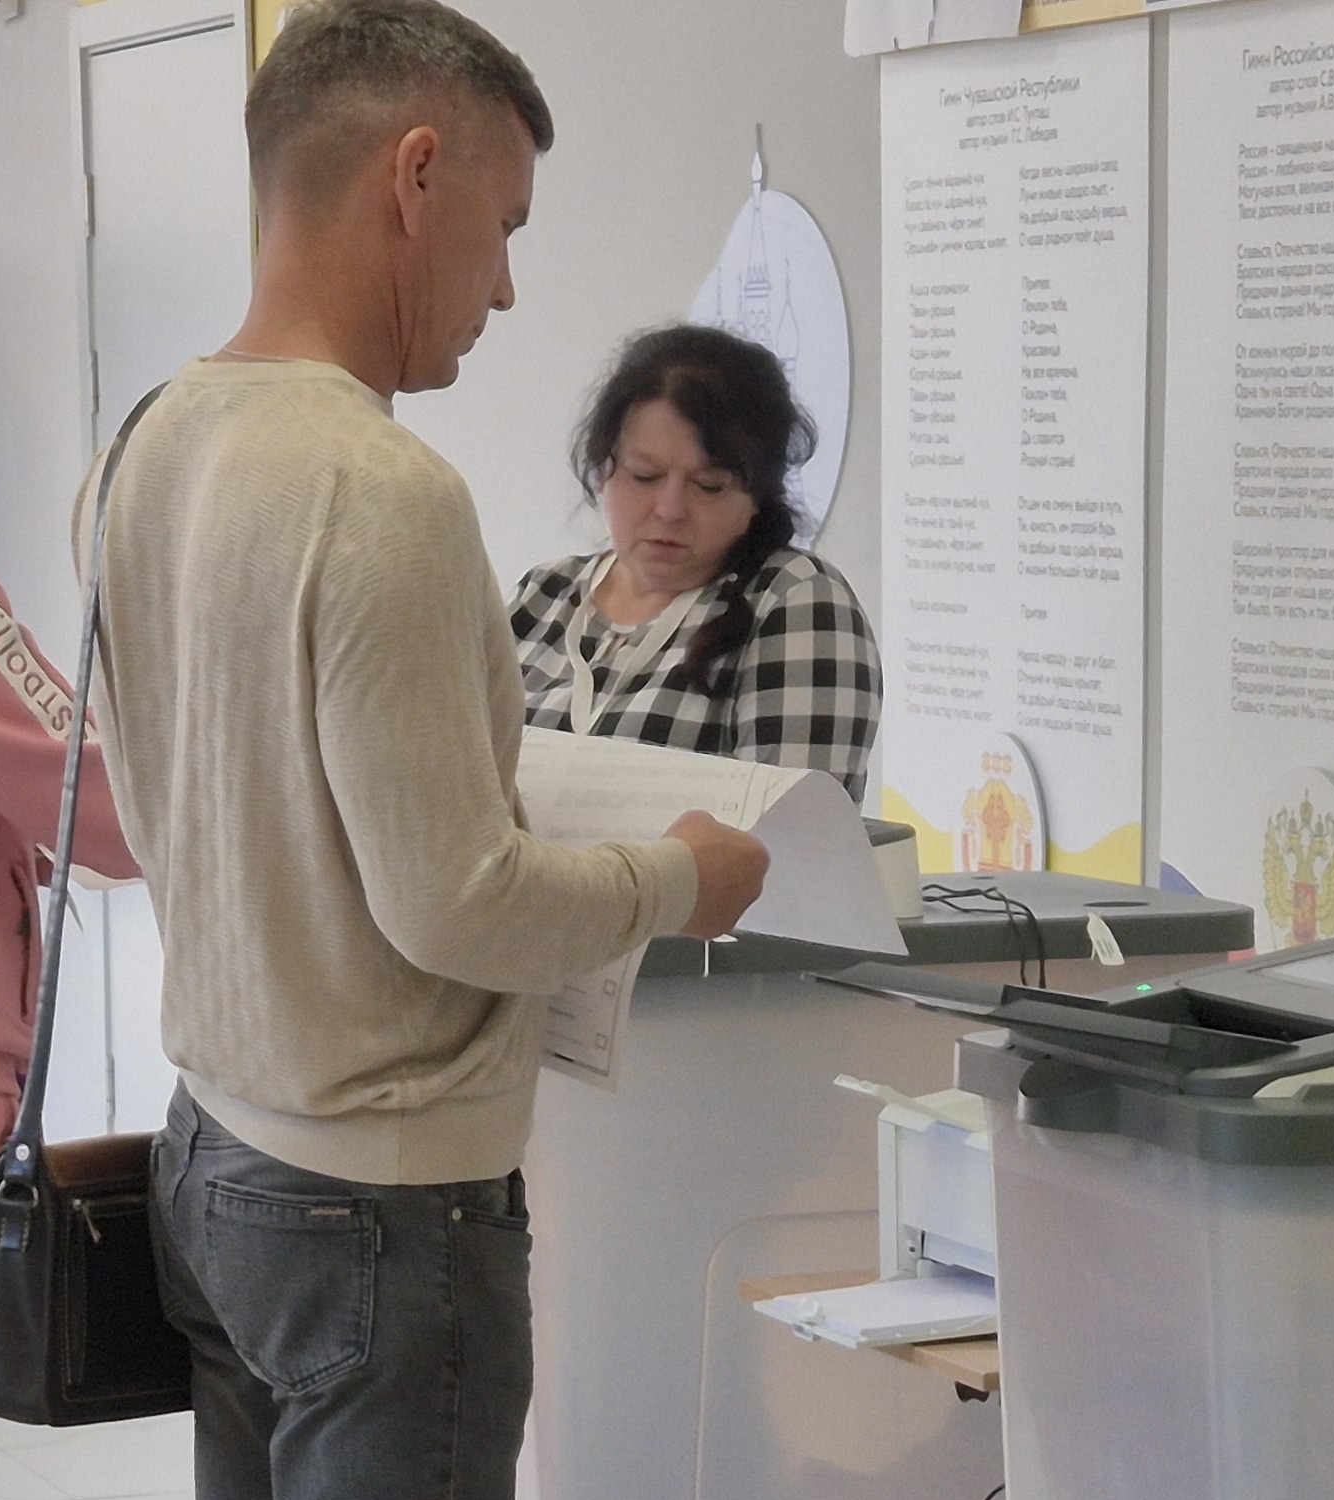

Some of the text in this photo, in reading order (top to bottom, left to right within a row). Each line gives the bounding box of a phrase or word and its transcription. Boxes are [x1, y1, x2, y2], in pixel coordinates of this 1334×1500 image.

[1243, 49, 1270, 70] Гимн
[964, 81, 1017, 108] Чувашской
[1020, 75, 1080, 100] Республики
